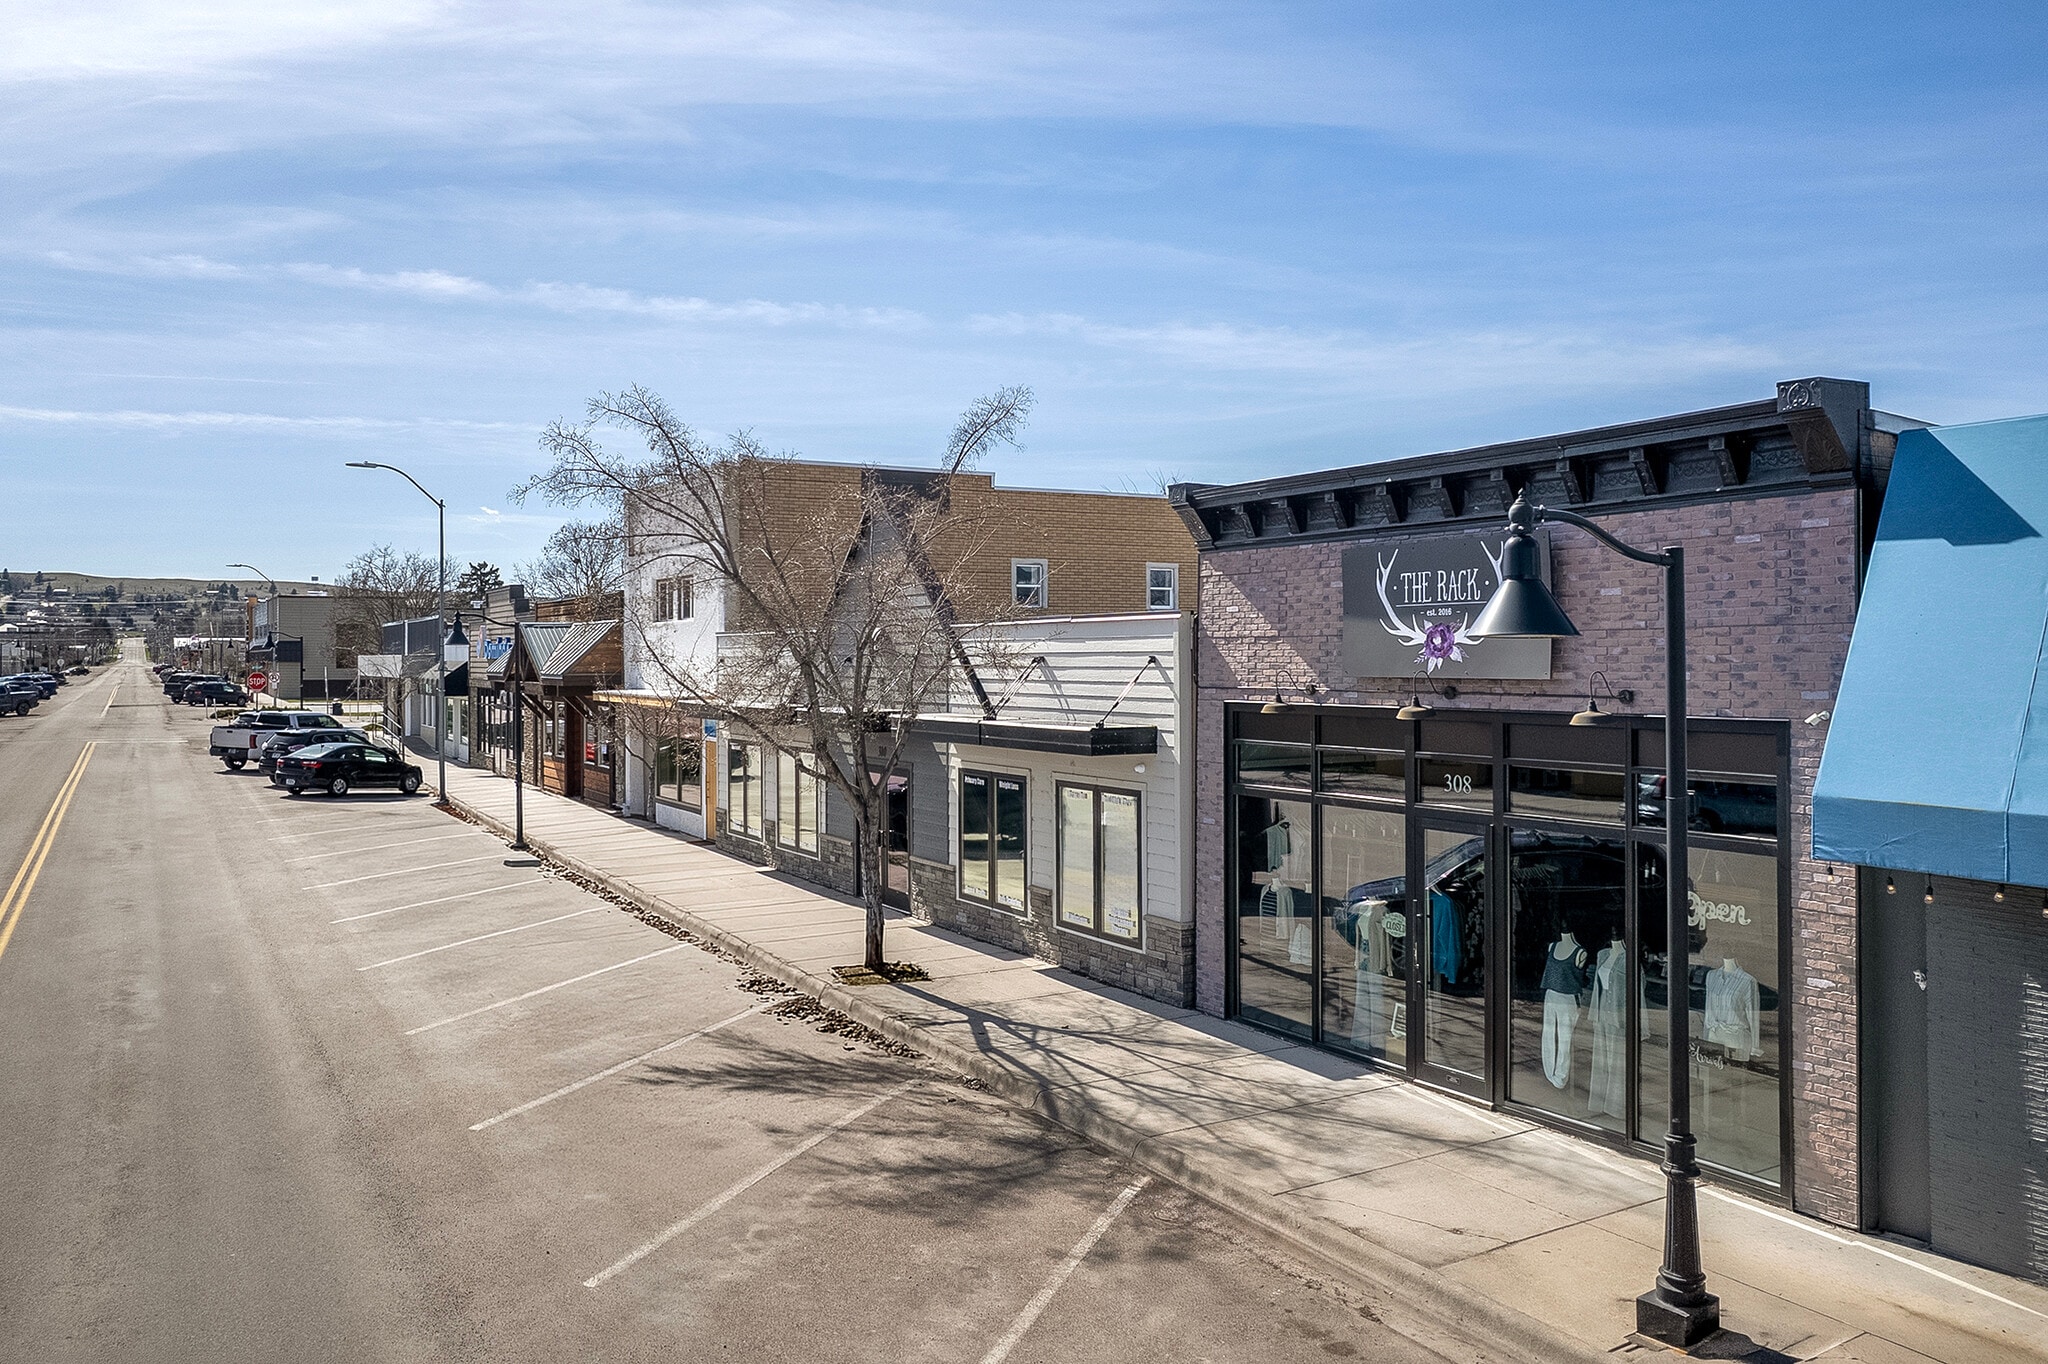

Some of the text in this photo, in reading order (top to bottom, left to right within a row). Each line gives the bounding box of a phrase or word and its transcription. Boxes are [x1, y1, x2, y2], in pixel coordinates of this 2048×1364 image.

[1400, 568, 1481, 603] THE RACK
[1438, 608, 1453, 616] 2016
[249, 677, 266, 686] STOP
[1443, 773, 1472, 795] 308
[1687, 890, 1752, 930] Open
